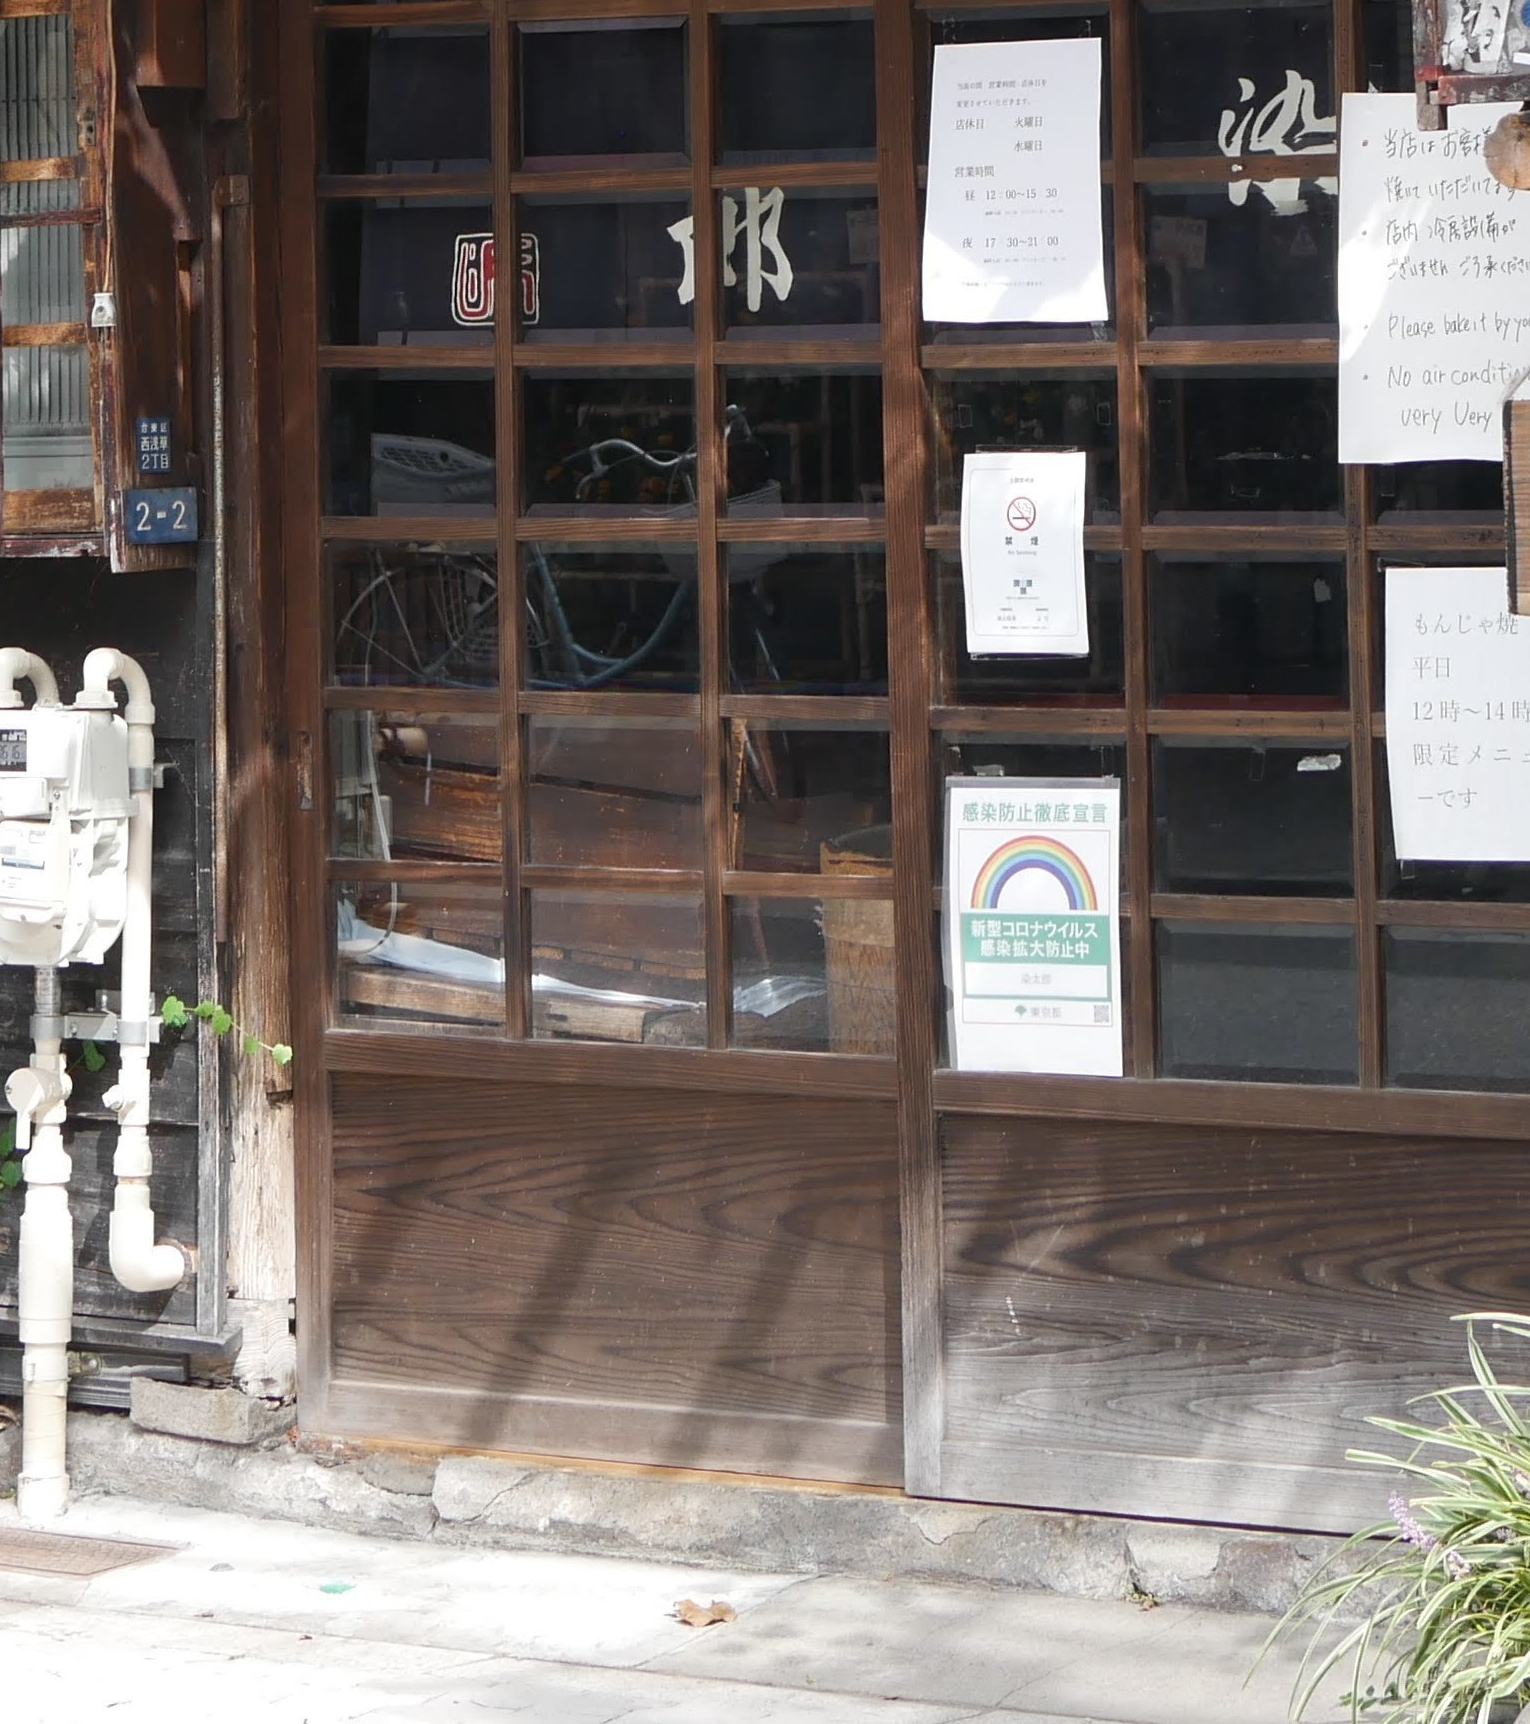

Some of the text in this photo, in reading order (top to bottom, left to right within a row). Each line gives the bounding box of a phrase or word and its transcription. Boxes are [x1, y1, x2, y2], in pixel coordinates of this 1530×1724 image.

[955, 116, 1043, 131] 店休日 火曜日
[1013, 140, 1043, 153] 水曜日
[1384, 128, 1436, 159] 当店は
[954, 165, 995, 178] 営業時間
[1385, 219, 1418, 245] 店内
[1387, 312, 1436, 340] Please
[1443, 313, 1470, 335] bake
[1473, 311, 1487, 332] it
[1494, 311, 1511, 341] by
[1387, 365, 1411, 388] No
[1422, 368, 1445, 385] air
[1400, 407, 1442, 434] very
[140, 435, 169, 452] 西浅草
[141, 453, 169, 470] 2丁目
[135, 500, 188, 532] 2-2
[1412, 611, 1520, 636] もんじゃ焼
[1412, 655, 1452, 680] 平日
[962, 801, 1108, 825] 感染防止徹底宣言
[970, 919, 1099, 939] 新型コロナウイルス
[979, 939, 1090, 959] 感染拡大防止中
[1029, 1006, 1062, 1019] 東京都
